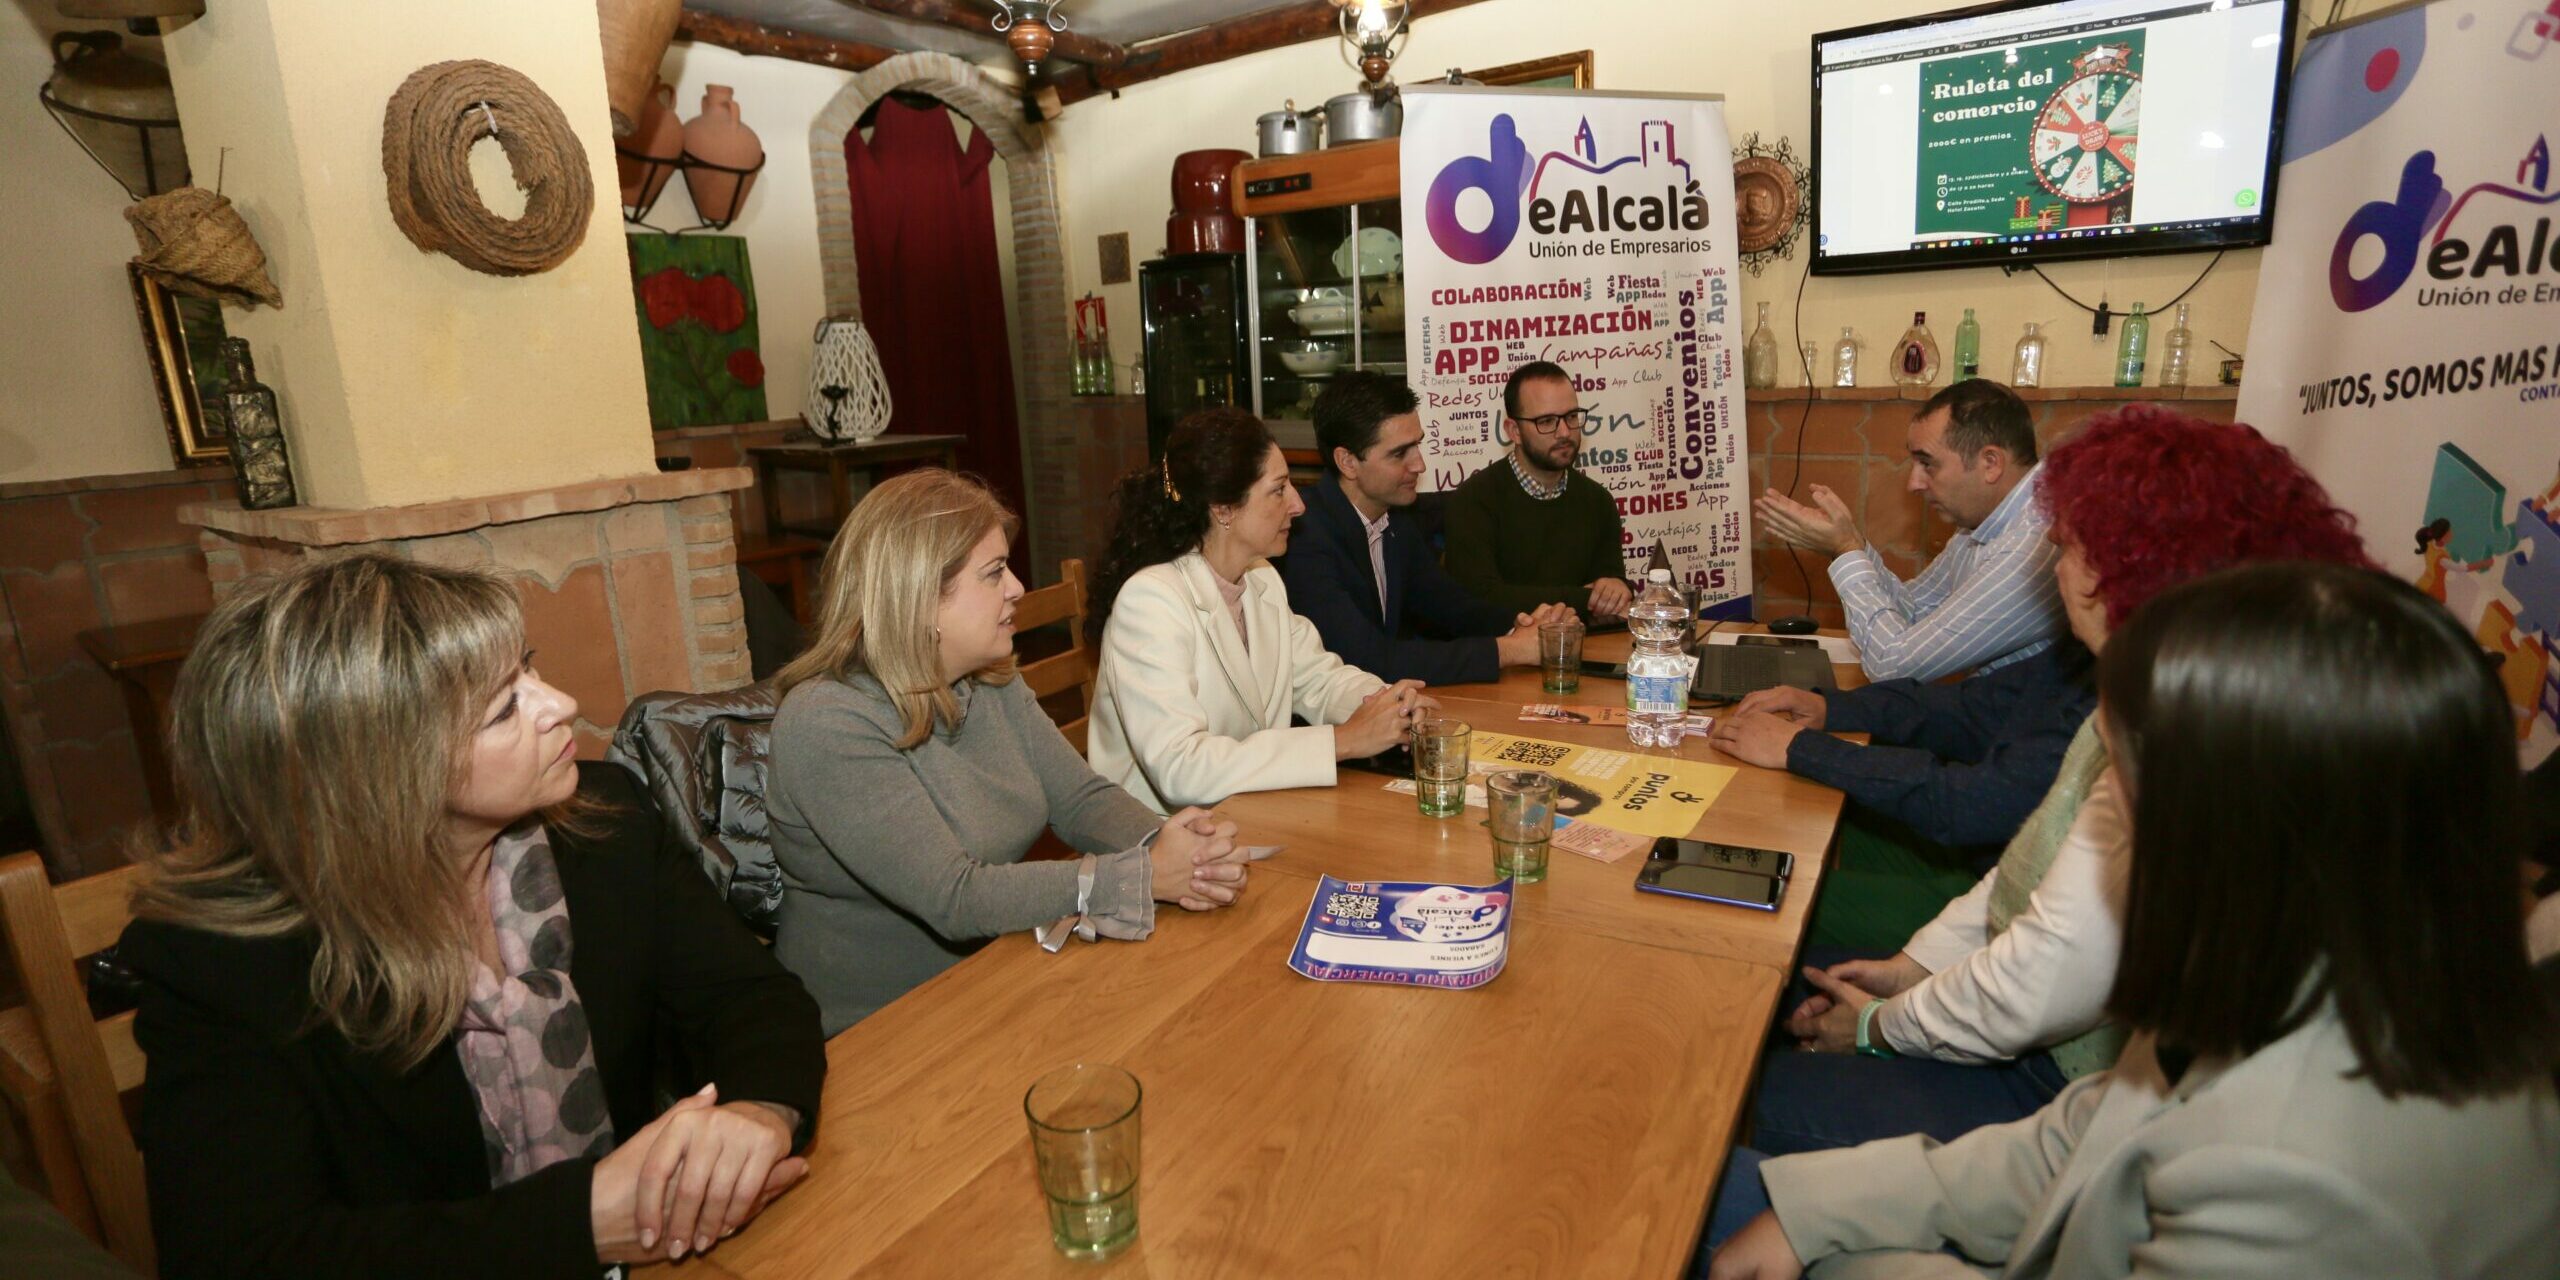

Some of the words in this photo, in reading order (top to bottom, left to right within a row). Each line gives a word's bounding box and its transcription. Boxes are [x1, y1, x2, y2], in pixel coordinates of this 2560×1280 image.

[1934, 76, 2010, 99] Ruleta
[2018, 68, 2053, 88] del
[1933, 97, 2037, 123] comercio
[1974, 132, 2012, 143] premios
[1529, 240, 1575, 258] Unión
[1582, 240, 1605, 255] de
[1610, 238, 1712, 258] Empresarios
[1618, 274, 1660, 289] Fiesta
[1703, 267, 1726, 277] Web
[1431, 278, 1582, 306] COLABORACIÓN
[1584, 277, 1592, 301] Web
[1607, 275, 1615, 299] Web
[1641, 290, 1666, 299] Redes
[1696, 278, 1704, 300] WEB
[2417, 285, 2490, 307] Unión
[2498, 285, 2527, 304] de
[1707, 277, 1728, 324] App
[1450, 304, 1652, 344] DINAMIZACIÓN
[1654, 319, 1670, 328] APP
[1422, 315, 1431, 364] DEFENSA
[1506, 341, 1525, 350] WEB
[1698, 333, 1722, 343] Club
[1435, 346, 1500, 376] APP
[1507, 352, 1536, 362] Unión
[1540, 340, 1664, 369] Campañas
[1723, 349, 1732, 379] Todos
[1633, 368, 1662, 384] Club
[1700, 357, 1708, 389] REDES
[1713, 353, 1723, 389] Todos
[2383, 356, 2485, 401] SOMOS
[2490, 345, 2547, 388] MAS
[1674, 290, 1704, 480] Convenios
[2519, 383, 2560, 402] CONT
[1427, 387, 1483, 409] Redes
[1449, 410, 1488, 421] JUNTOS
[1718, 396, 1729, 429] UNIÓN
[1426, 419, 1441, 455] Web
[1480, 421, 1489, 442] WEB
[1664, 386, 1678, 481] Promoción
[1703, 400, 1717, 456] TODOS
[1443, 436, 1477, 447] Socios
[1635, 440, 1655, 449] Web
[1726, 434, 1735, 464] Unión
[1443, 448, 1484, 458] Acciones
[1634, 449, 1664, 461] CLUB
[1601, 464, 1632, 474] TODOS
[1638, 461, 1664, 471] Fiesta
[1649, 472, 1666, 481] App
[1706, 459, 1715, 479] App
[1714, 457, 1724, 478] App
[1651, 483, 1666, 492] APP
[1689, 482, 1730, 492] Acciones
[1615, 490, 1688, 516] IONES
[1697, 492, 1729, 510] App
[1637, 520, 1702, 539] Ventajas
[1723, 513, 1731, 542] Todos
[1731, 511, 1740, 542] Socios
[1671, 545, 1698, 556] REDES
[1709, 524, 1718, 557] Socios
[1720, 546, 1740, 554] APP
[1707, 560, 1736, 569] Todos
[1622, 772, 1671, 812] puntos
[1304, 962, 1410, 984] COMERCIAL
[1415, 965, 1499, 987] HORARIO
